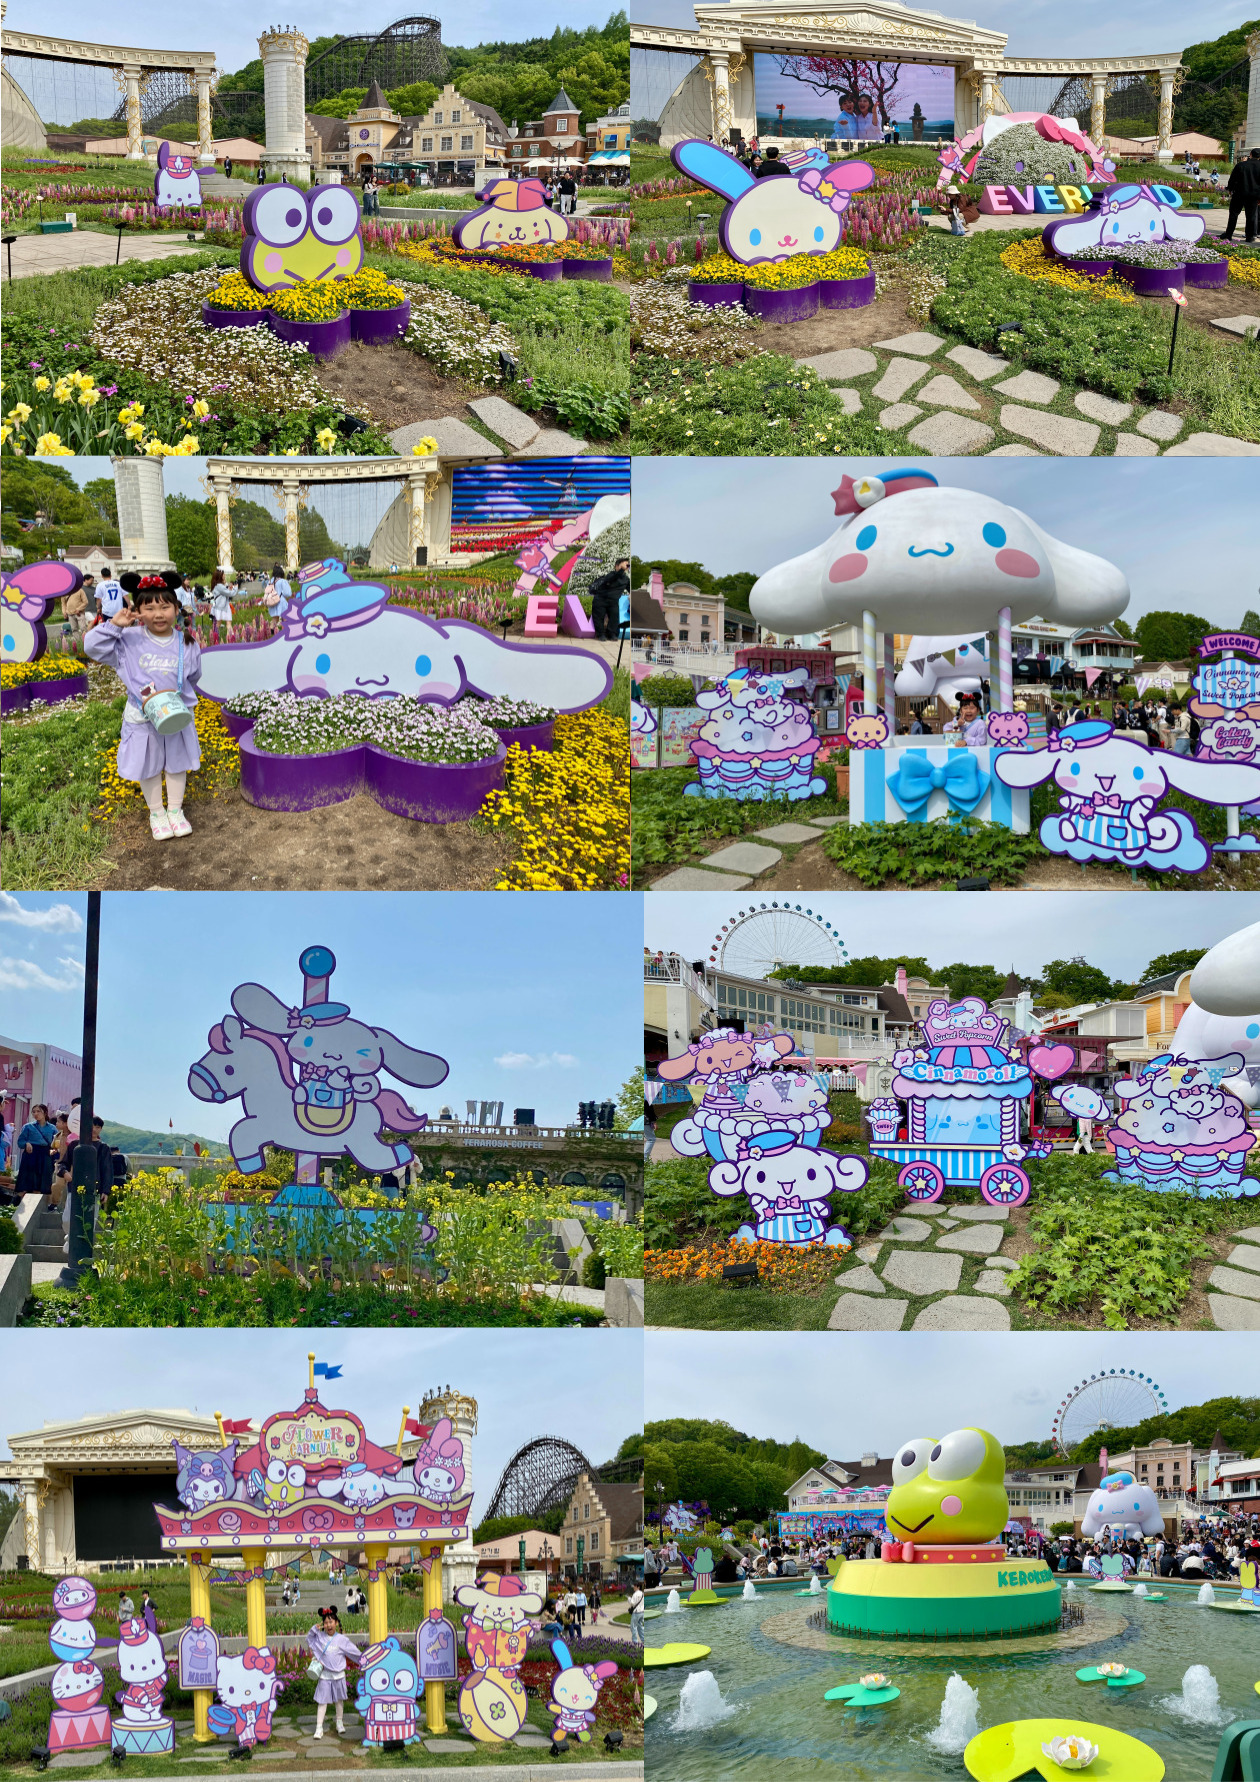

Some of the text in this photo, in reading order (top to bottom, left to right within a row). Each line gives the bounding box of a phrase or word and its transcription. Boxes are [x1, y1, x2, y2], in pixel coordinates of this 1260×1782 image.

[978, 185, 1183, 215] EVERD
[107, 588, 118, 600] 17
[1209, 637, 1255, 650] WELCOME
[1202, 690, 1226, 699] Sweet
[1215, 726, 1251, 738] Cotton
[1216, 737, 1254, 749] Candy
[934, 1030, 993, 1042] Sweet Popcorn
[913, 1064, 1016, 1082] Cinnamoroll
[463, 1138, 544, 1149] TERAROSA COFFEE
[282, 1423, 343, 1443] FLOWER
[290, 1441, 338, 1457] CARNIVAL
[425, 1661, 450, 1675] MUSIC
[188, 1671, 212, 1684] MAGIC
